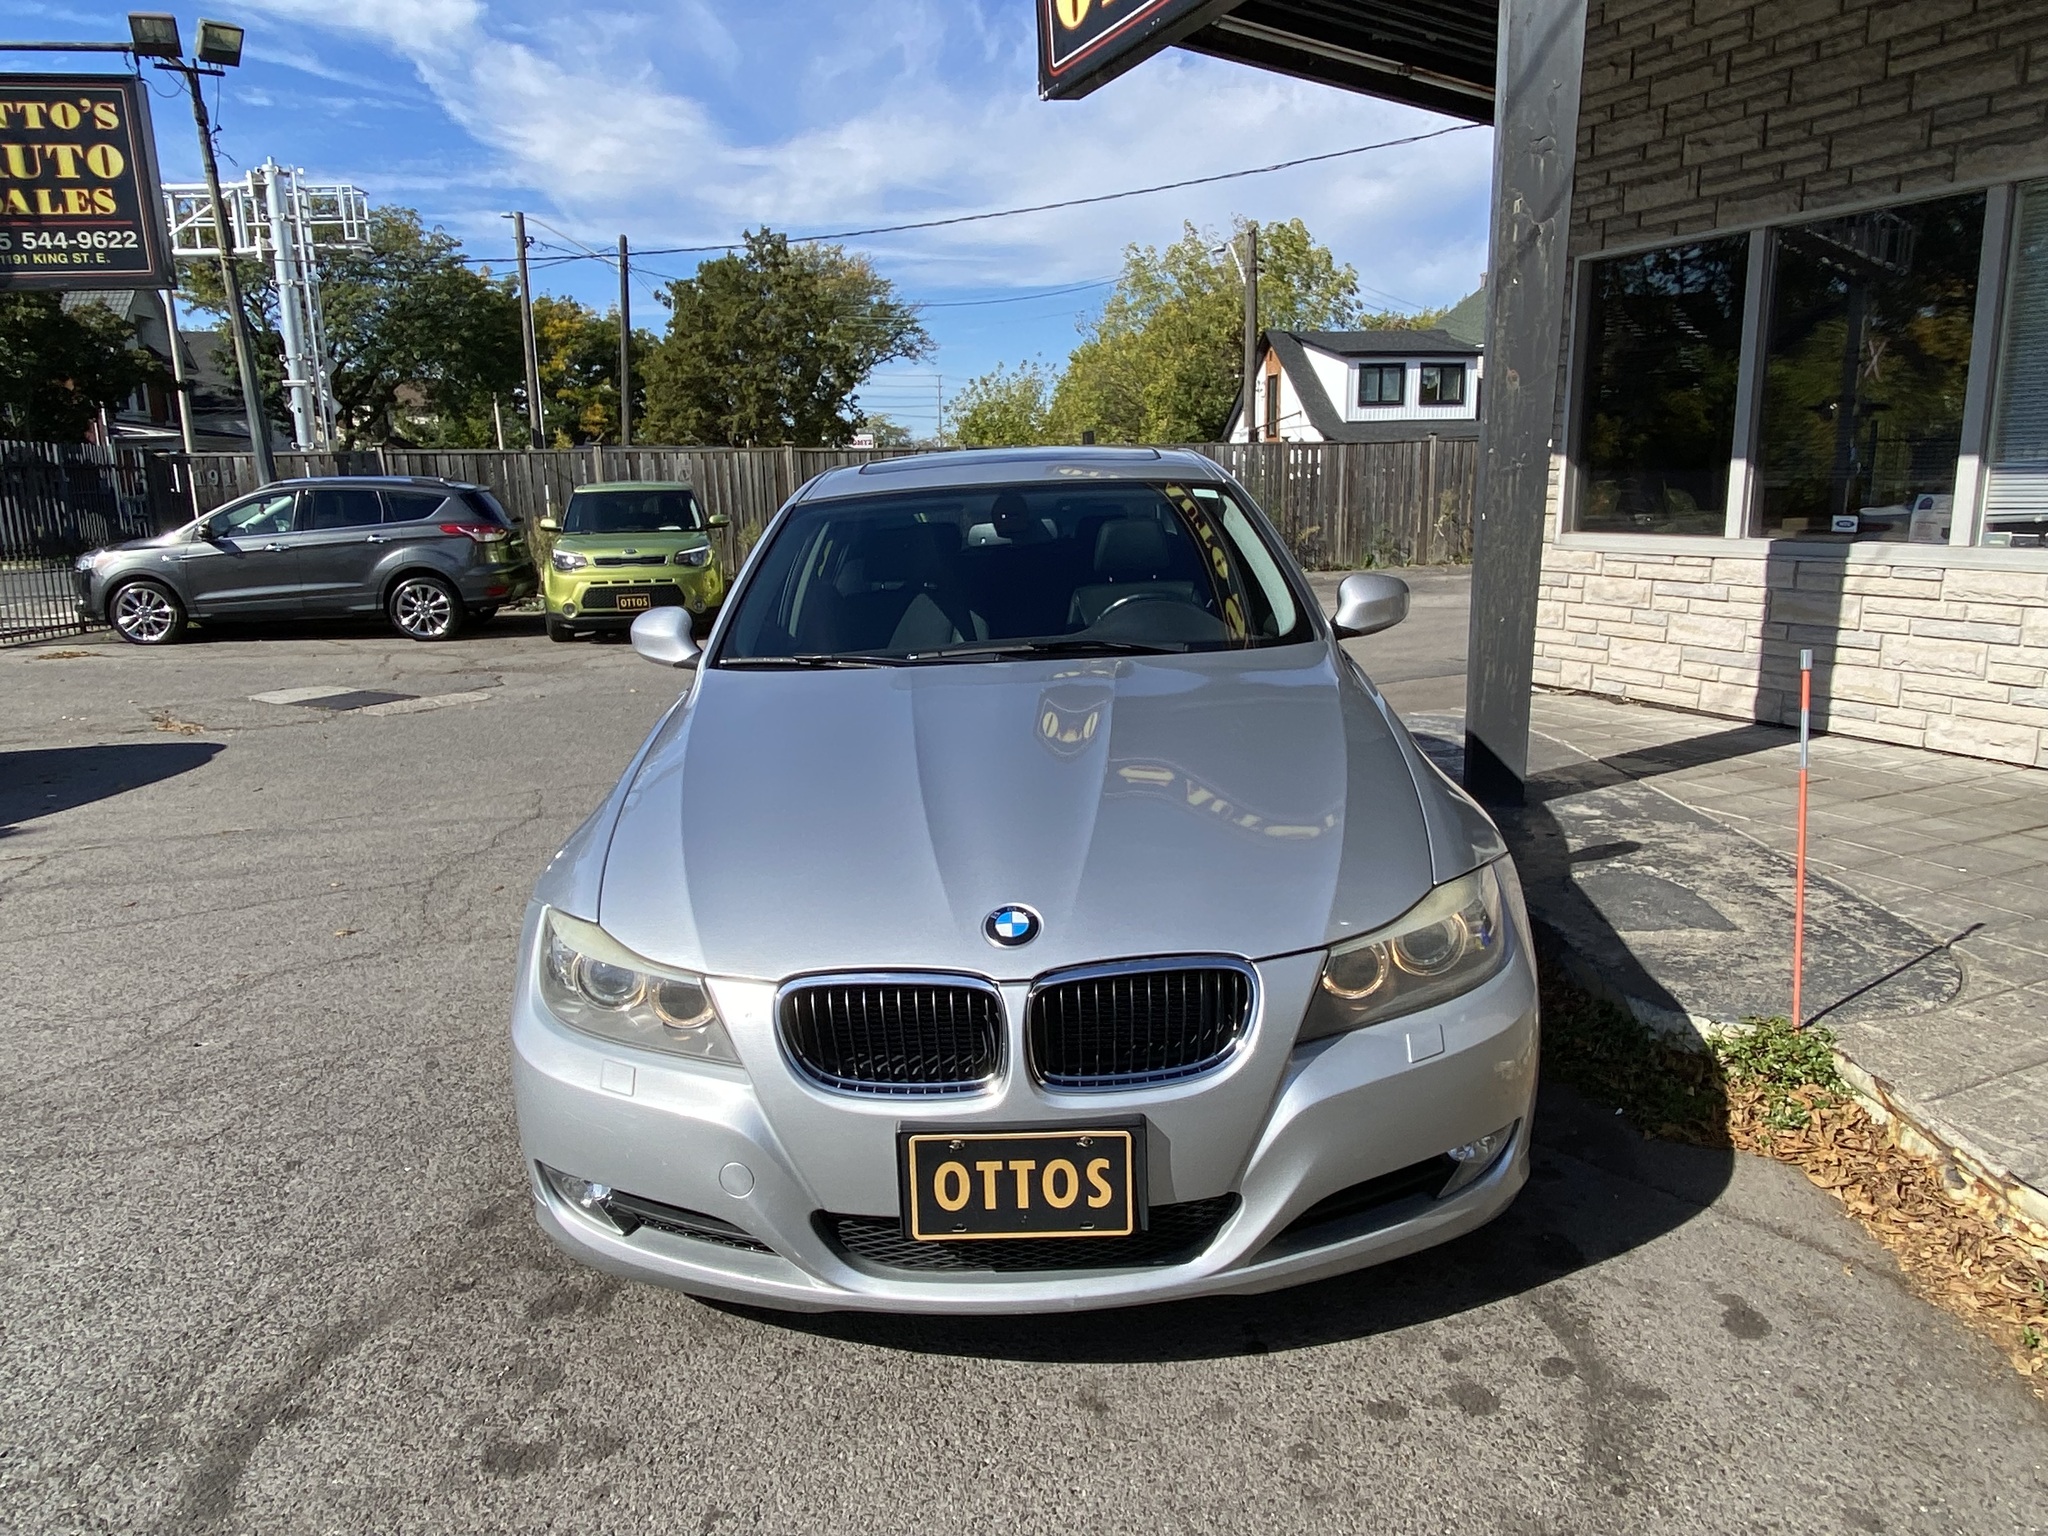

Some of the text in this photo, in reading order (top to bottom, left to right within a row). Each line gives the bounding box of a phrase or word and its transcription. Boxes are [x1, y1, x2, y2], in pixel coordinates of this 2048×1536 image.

[0, 144, 125, 179] UTO
[0, 187, 117, 215] ALES
[21, 230, 138, 250] 544-9622
[33, 252, 68, 265] KING
[72, 252, 94, 264] ST.
[96, 252, 111, 264] E.
[620, 597, 648, 608] OTTOS
[933, 1157, 1113, 1212] OTTOS
